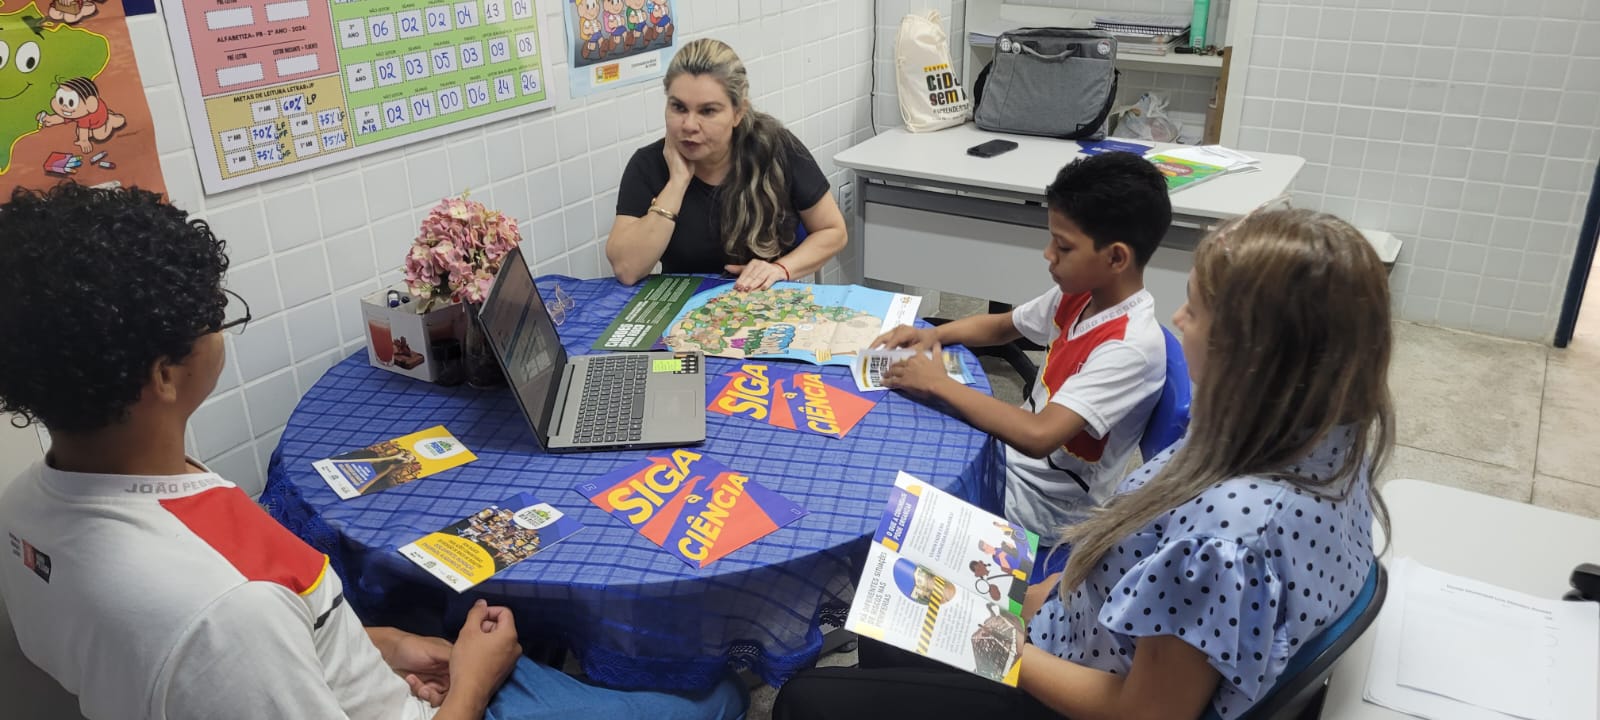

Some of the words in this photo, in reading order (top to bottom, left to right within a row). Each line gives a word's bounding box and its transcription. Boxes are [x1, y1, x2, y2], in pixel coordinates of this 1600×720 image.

[486, 3, 500, 19] 13
[514, 0, 527, 16] 04
[401, 17, 419, 33] 02
[428, 12, 446, 28] 02
[457, 9, 473, 26] 04
[275, 27, 288, 35] ANO
[347, 31, 360, 39] ANO
[372, 20, 389, 38] 06
[490, 42, 505, 57] 09
[518, 37, 532, 53] 08
[434, 52, 450, 70] 05
[463, 47, 479, 64] 03
[379, 62, 396, 80] 02
[405, 58, 424, 75] 03
[521, 74, 537, 91] 26
[233, 94, 254, 103] METAS
[263, 88, 286, 97] LEITURA
[283, 95, 302, 111] 60%
[306, 93, 317, 105] LP
[440, 91, 459, 110] 00
[468, 86, 486, 105] 06
[929, 88, 959, 106] sem
[387, 106, 405, 124] 02
[413, 99, 431, 116] 04
[319, 111, 335, 126] 75%
[252, 125, 272, 139] 70%
[276, 121, 286, 131] LF
[717, 363, 770, 421] SIGA
[782, 391, 798, 400] a
[797, 373, 835, 434] CIÊNCIA
[124, 481, 178, 494] JOÃO
[607, 448, 702, 525] SIGA
[684, 493, 703, 504] a
[677, 473, 749, 561] CIÊNCIA
[888, 520, 897, 532] QUE
[893, 526, 904, 541] PODE
[863, 577, 879, 613] DIFERENTES
[874, 551, 887, 577] SITUAÇÕES
[878, 581, 887, 593] NAS
[870, 593, 883, 615] RISCOS
[875, 593, 892, 627] PERIFERIAS
[867, 615, 875, 625] DE
